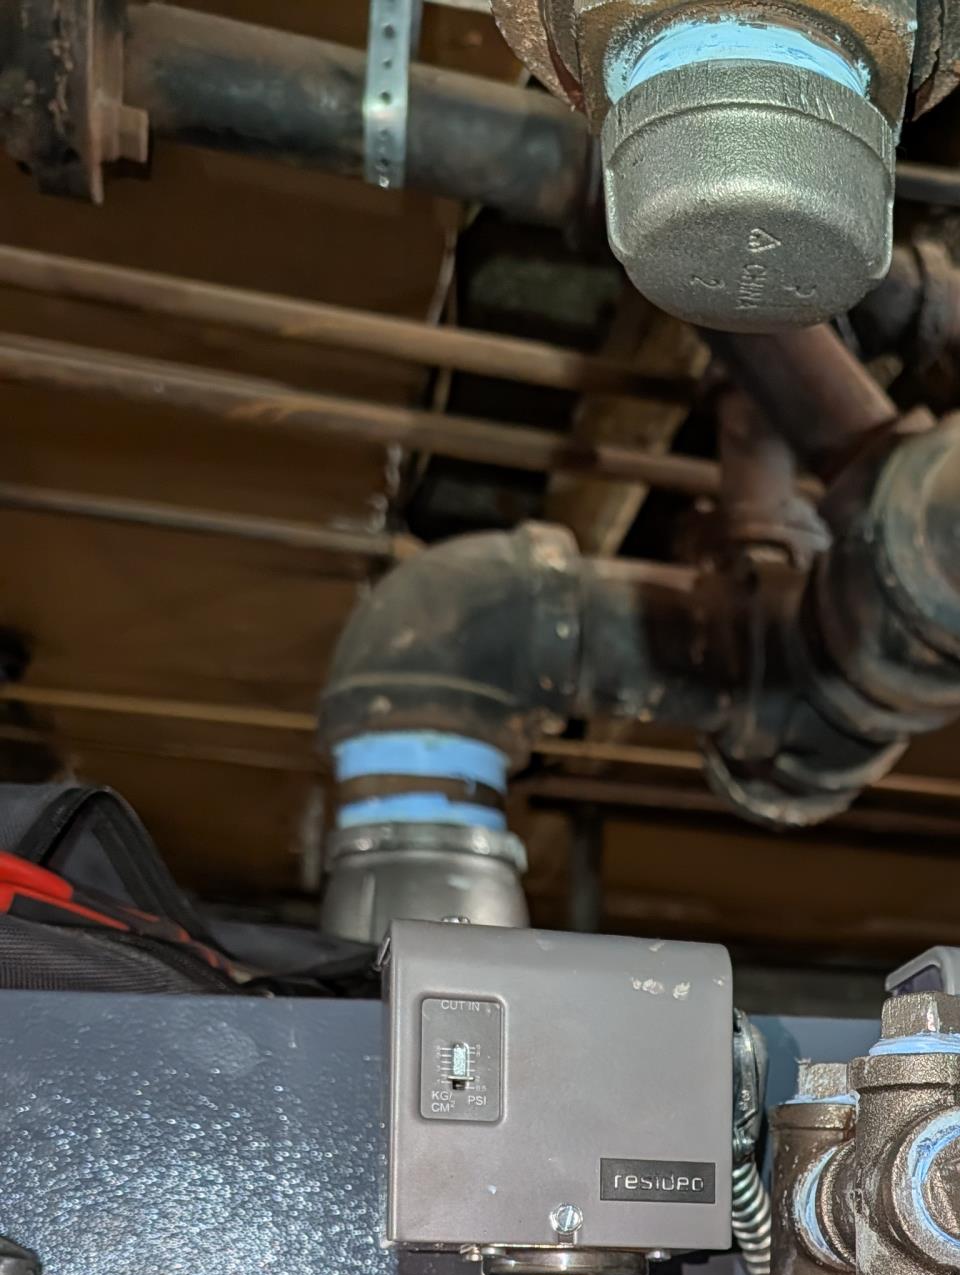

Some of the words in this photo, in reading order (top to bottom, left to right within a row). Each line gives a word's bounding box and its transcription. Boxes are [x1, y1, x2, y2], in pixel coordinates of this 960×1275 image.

[441, 1000, 464, 1011] CUT
[467, 1001, 480, 1012] IN
[468, 1096, 487, 1106] PSI
